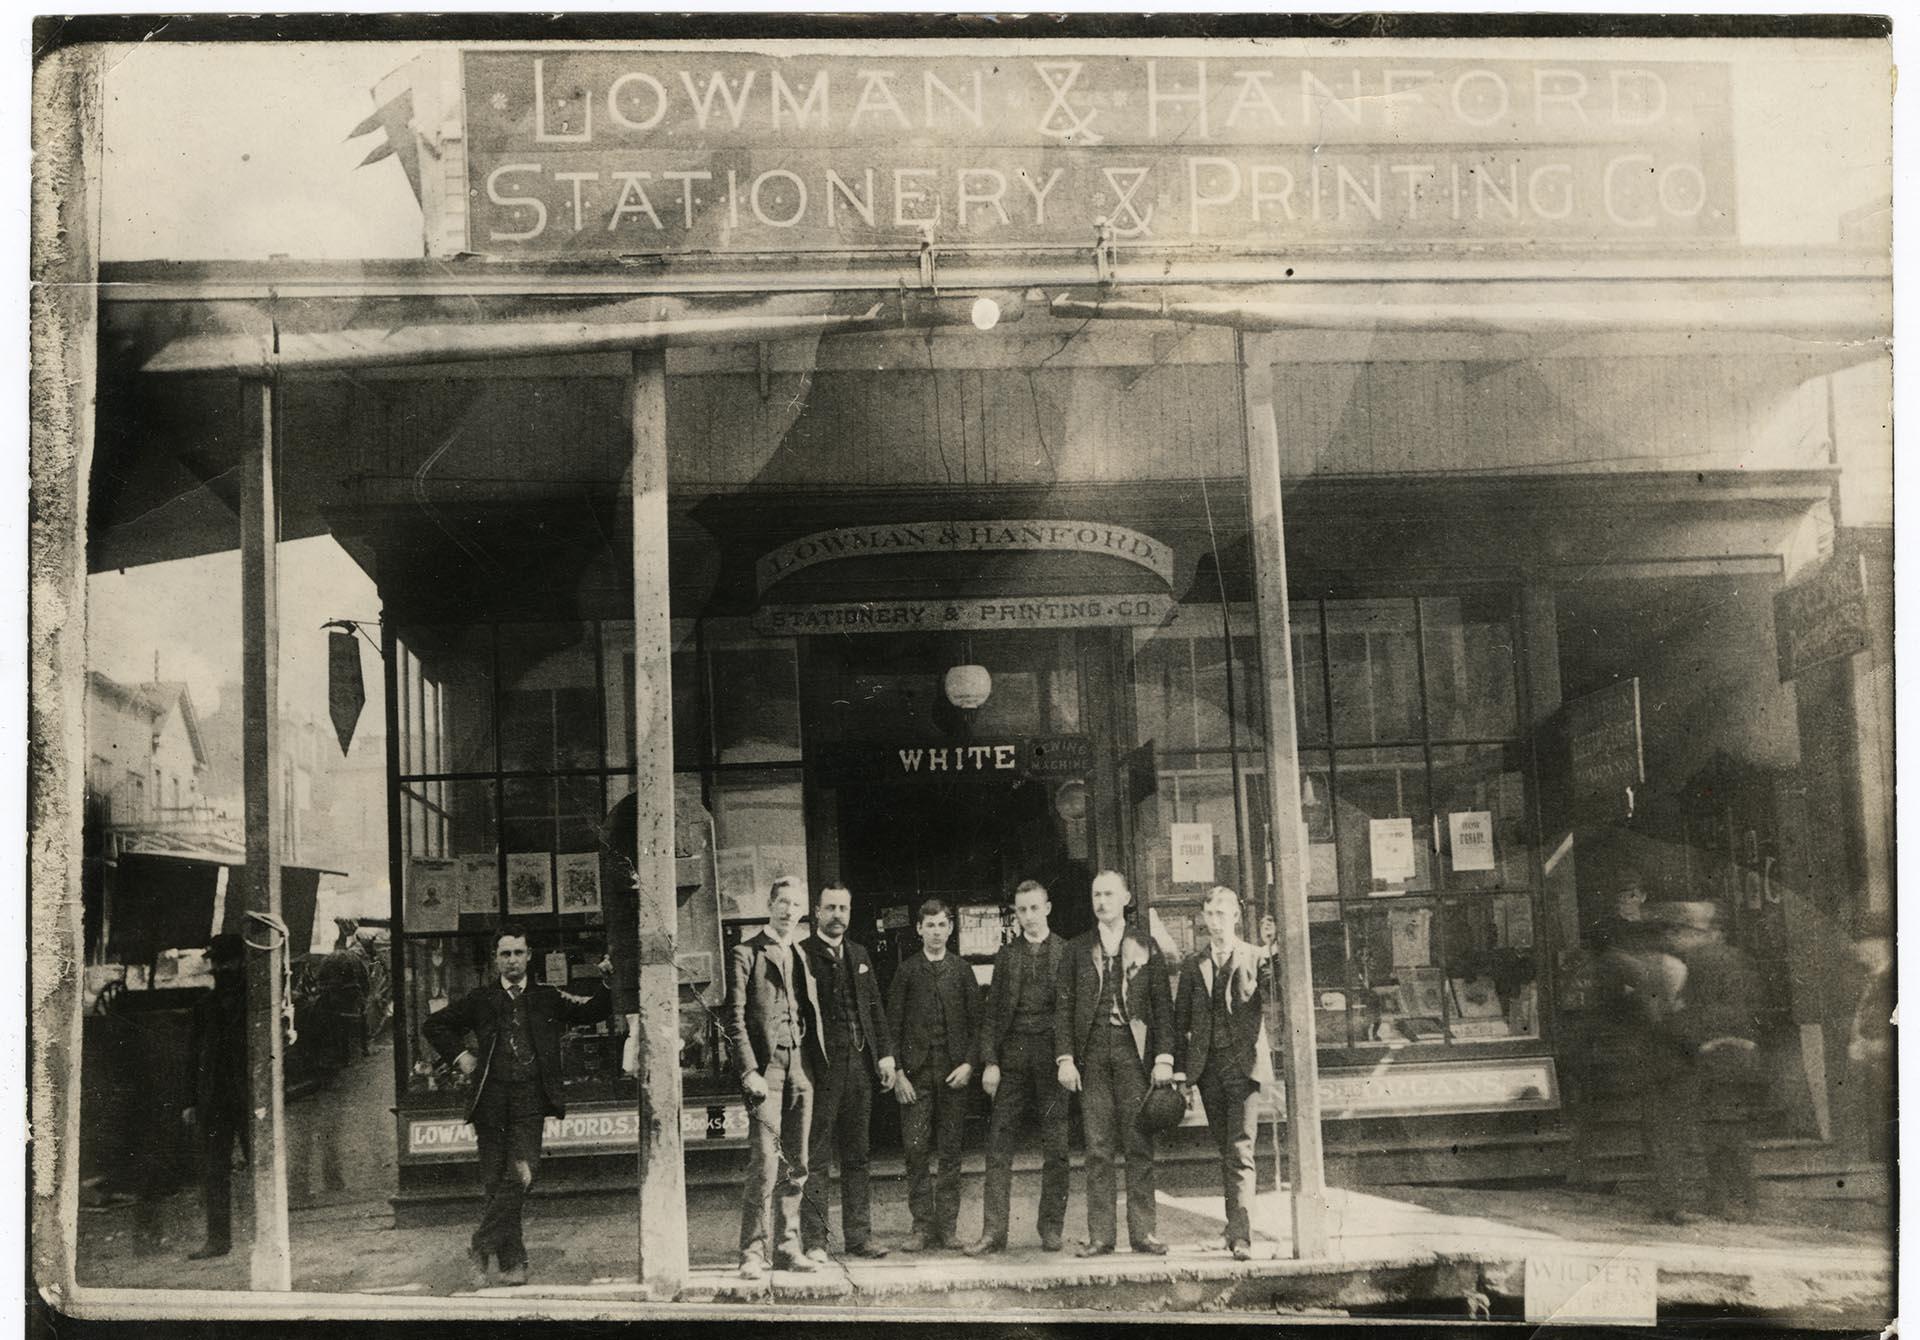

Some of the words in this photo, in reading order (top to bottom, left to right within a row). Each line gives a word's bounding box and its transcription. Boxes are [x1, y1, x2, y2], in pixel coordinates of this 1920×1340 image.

[534, 57, 983, 143] LOWMAN
[1034, 61, 1104, 147] &
[485, 162, 1065, 241] STATIONERY
[1102, 166, 1155, 238] &
[1187, 156, 1575, 234] PRINTING
[769, 529, 925, 573] LOWMAN
[938, 526, 960, 545] &
[772, 606, 925, 627] STATIONERY
[945, 606, 960, 621] &
[980, 602, 1101, 620] PRINTING
[899, 745, 1016, 771] WHITE
[414, 1124, 478, 1145] LOWM
